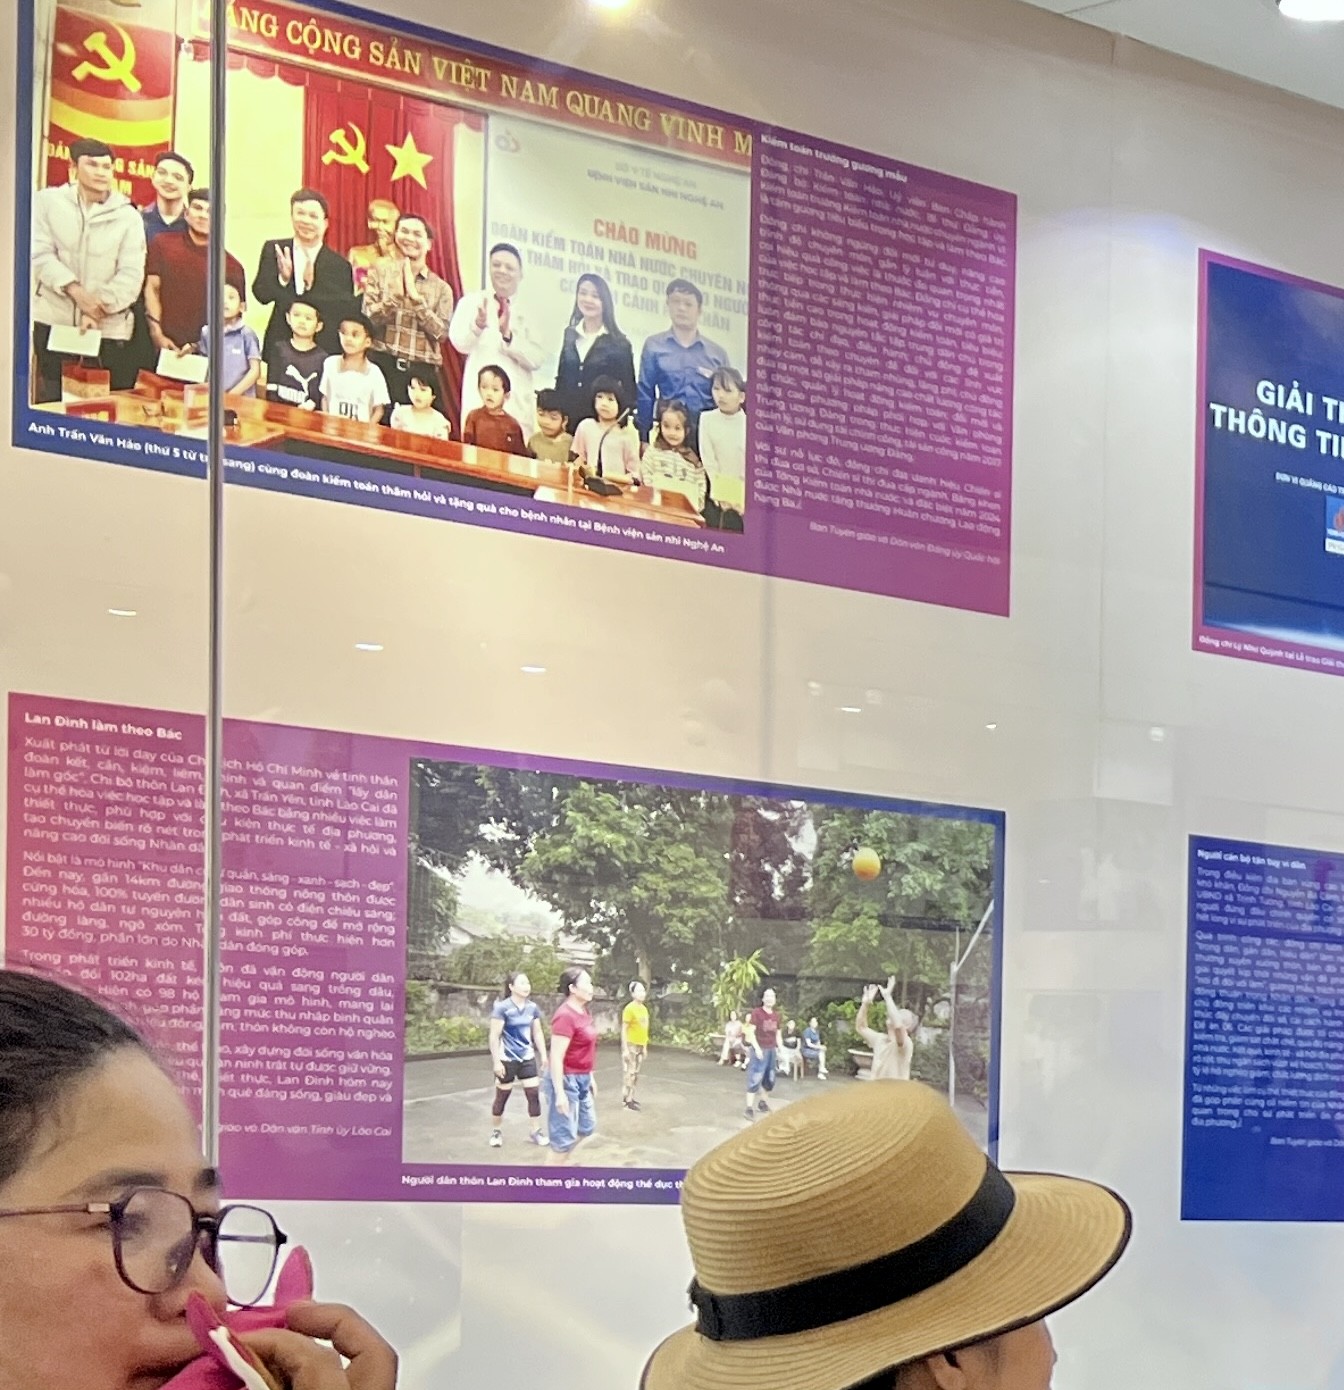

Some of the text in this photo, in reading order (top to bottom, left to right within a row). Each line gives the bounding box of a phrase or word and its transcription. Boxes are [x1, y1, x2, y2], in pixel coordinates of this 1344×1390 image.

[286, 18, 361, 60] CỘNG
[369, 35, 421, 76] SẢN
[433, 56, 490, 93] VIỆT
[501, 74, 559, 109] NAM
[566, 90, 651, 132] QUANG
[660, 112, 723, 149] VINH
[594, 218, 697, 260] CHÀO MỪNG
[1256, 379, 1314, 416] GIẢI
[1209, 402, 1306, 449] THÔNG
[25, 712, 181, 740] Lan Đình làm theo Bác
